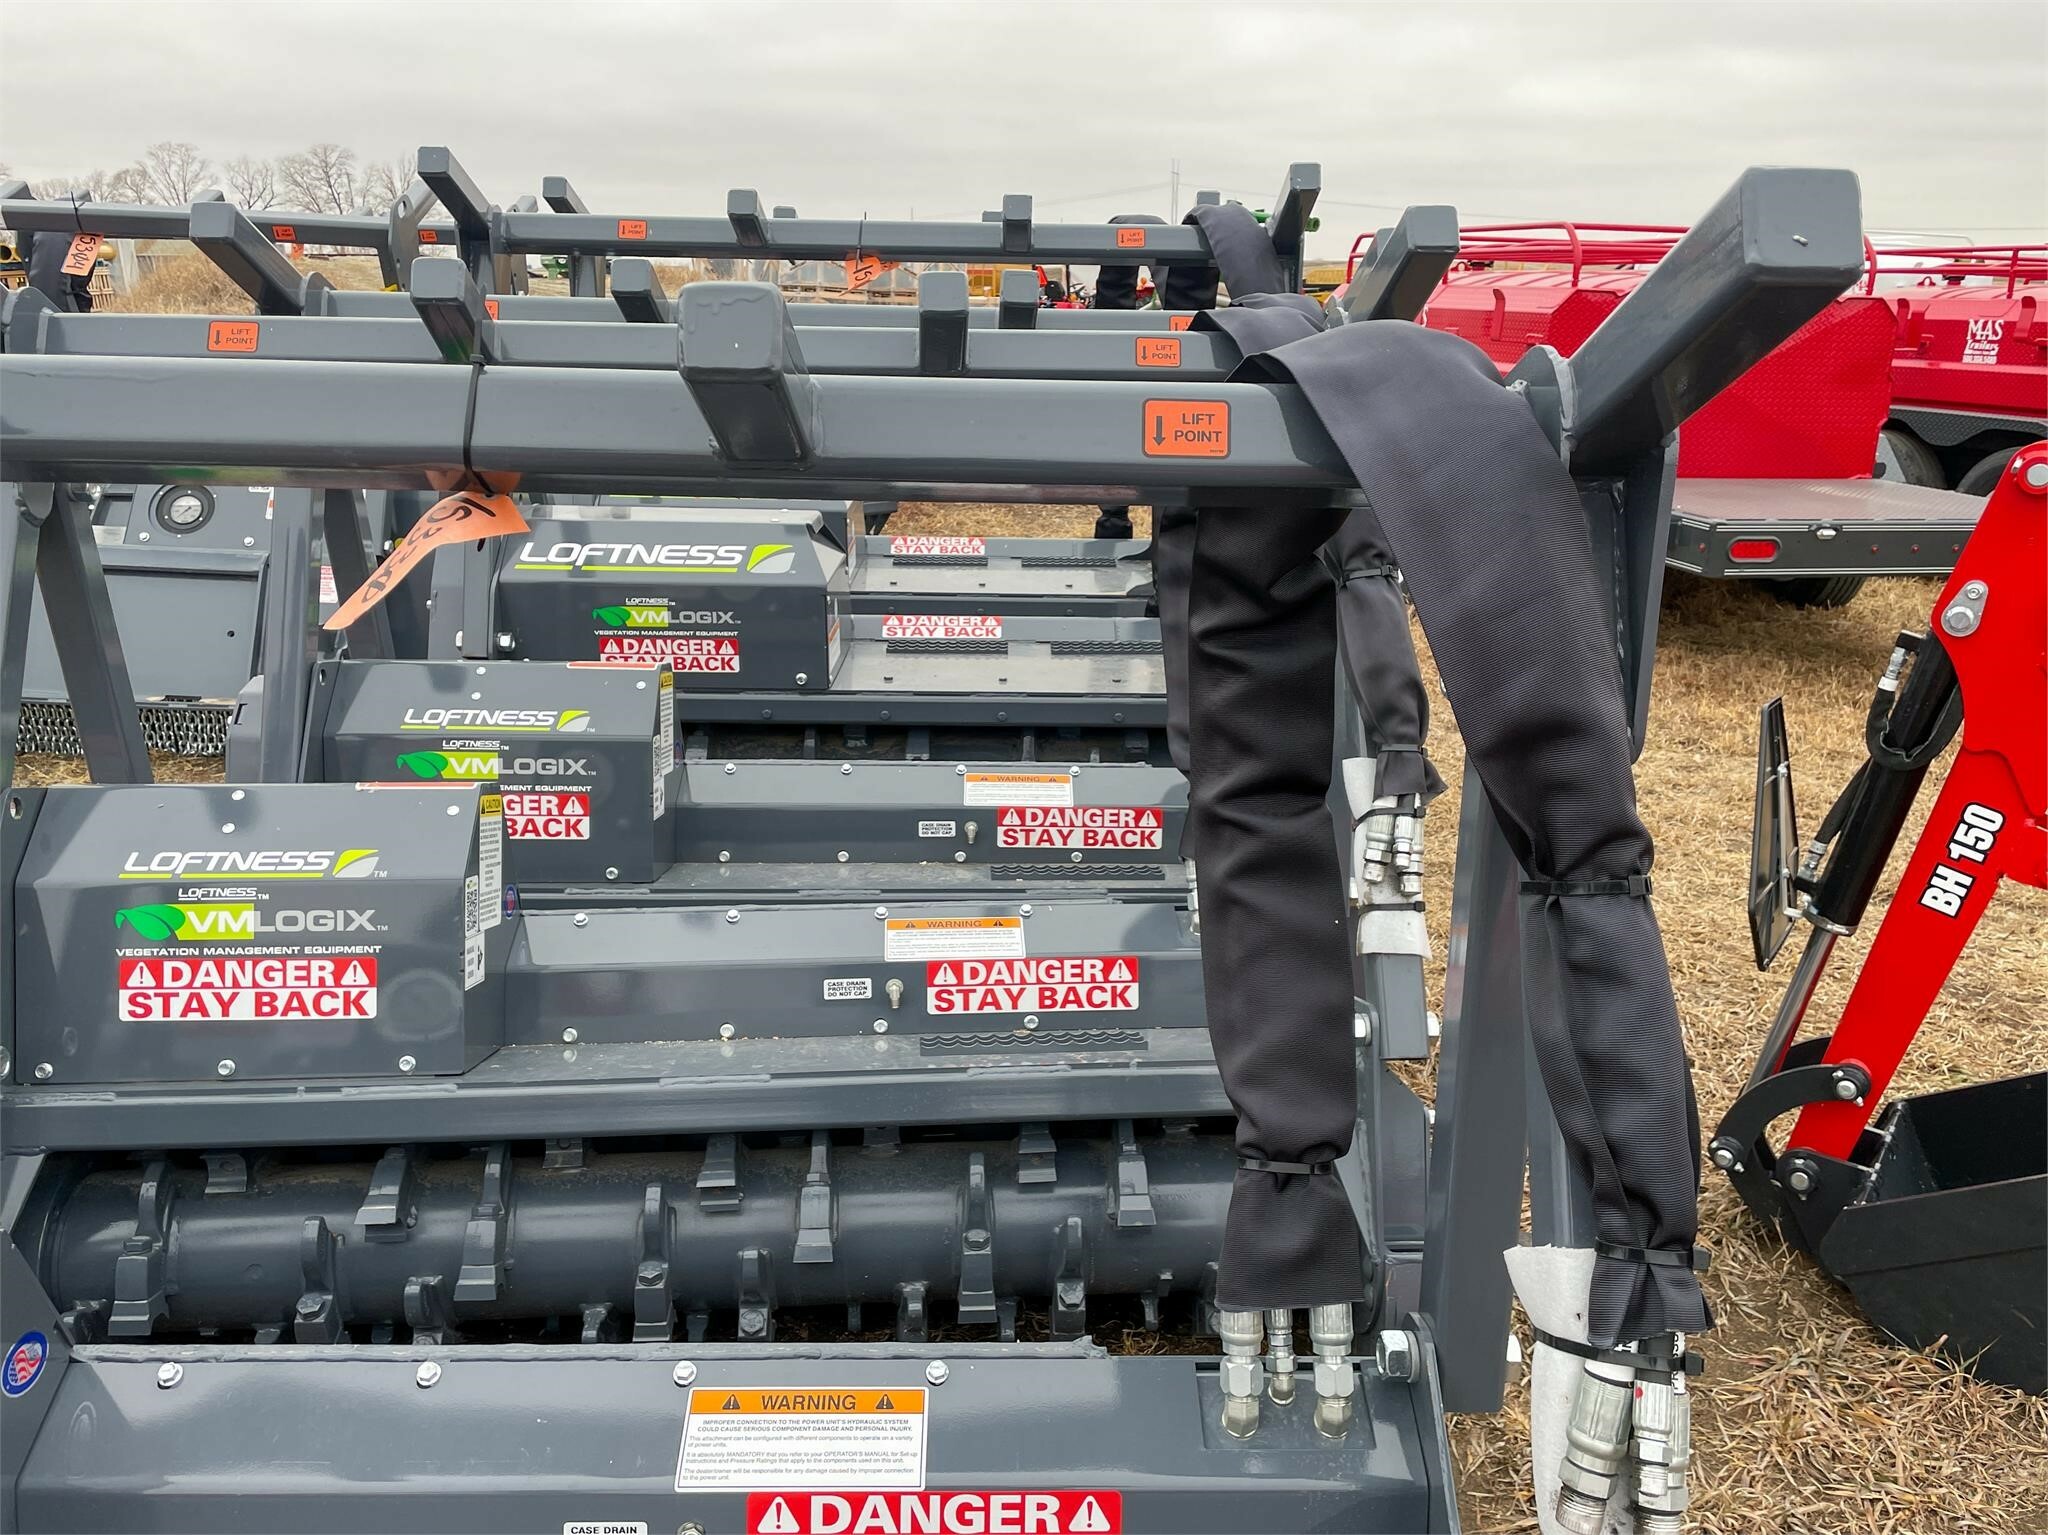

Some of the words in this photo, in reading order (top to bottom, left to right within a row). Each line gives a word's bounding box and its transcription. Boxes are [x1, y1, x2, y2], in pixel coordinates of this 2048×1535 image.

[1966, 319, 2004, 340] MAS
[1182, 413, 1216, 425] LIFT
[1174, 430, 1222, 442] POINT
[906, 536, 968, 546] DANGER
[519, 541, 748, 566] LOFTNESS
[894, 546, 932, 554] STAY
[939, 546, 981, 554] BACK
[630, 610, 734, 624] VMLOGIX
[902, 616, 982, 626] DANGER
[886, 627, 938, 637] STAY
[944, 627, 998, 638] BACK
[622, 638, 716, 655] DANGER
[673, 656, 736, 672] BACK
[403, 708, 558, 726] LOFTNESS
[442, 740, 500, 749] LOFTNESS
[450, 758, 588, 776] VMLOGIX
[1025, 808, 1136, 828] DANGER
[1002, 828, 1076, 846] STAY
[1083, 829, 1156, 848] BACK
[124, 851, 335, 874] LOFTNESS
[1919, 863, 1975, 918] BH
[1947, 802, 2005, 864] 150
[178, 888, 257, 899] LOFTNESS
[186, 909, 376, 932] VMLOGIX
[926, 920, 982, 928] WARNING
[115, 948, 199, 956] VEGETATION
[203, 946, 300, 956] MANAGEMENT
[304, 945, 382, 954] EQUIPMENT
[163, 959, 335, 988] DANGER
[962, 959, 1104, 985] DANGER
[127, 991, 241, 1019] STAY
[254, 990, 370, 1017] BACK
[934, 987, 1029, 1012] STAY
[1038, 985, 1132, 1009] BACK
[761, 1394, 857, 1410] WARNING
[810, 1494, 1061, 1534] DANGER
[570, 1526, 600, 1534] CASE
[604, 1526, 638, 1534] DRAIN
